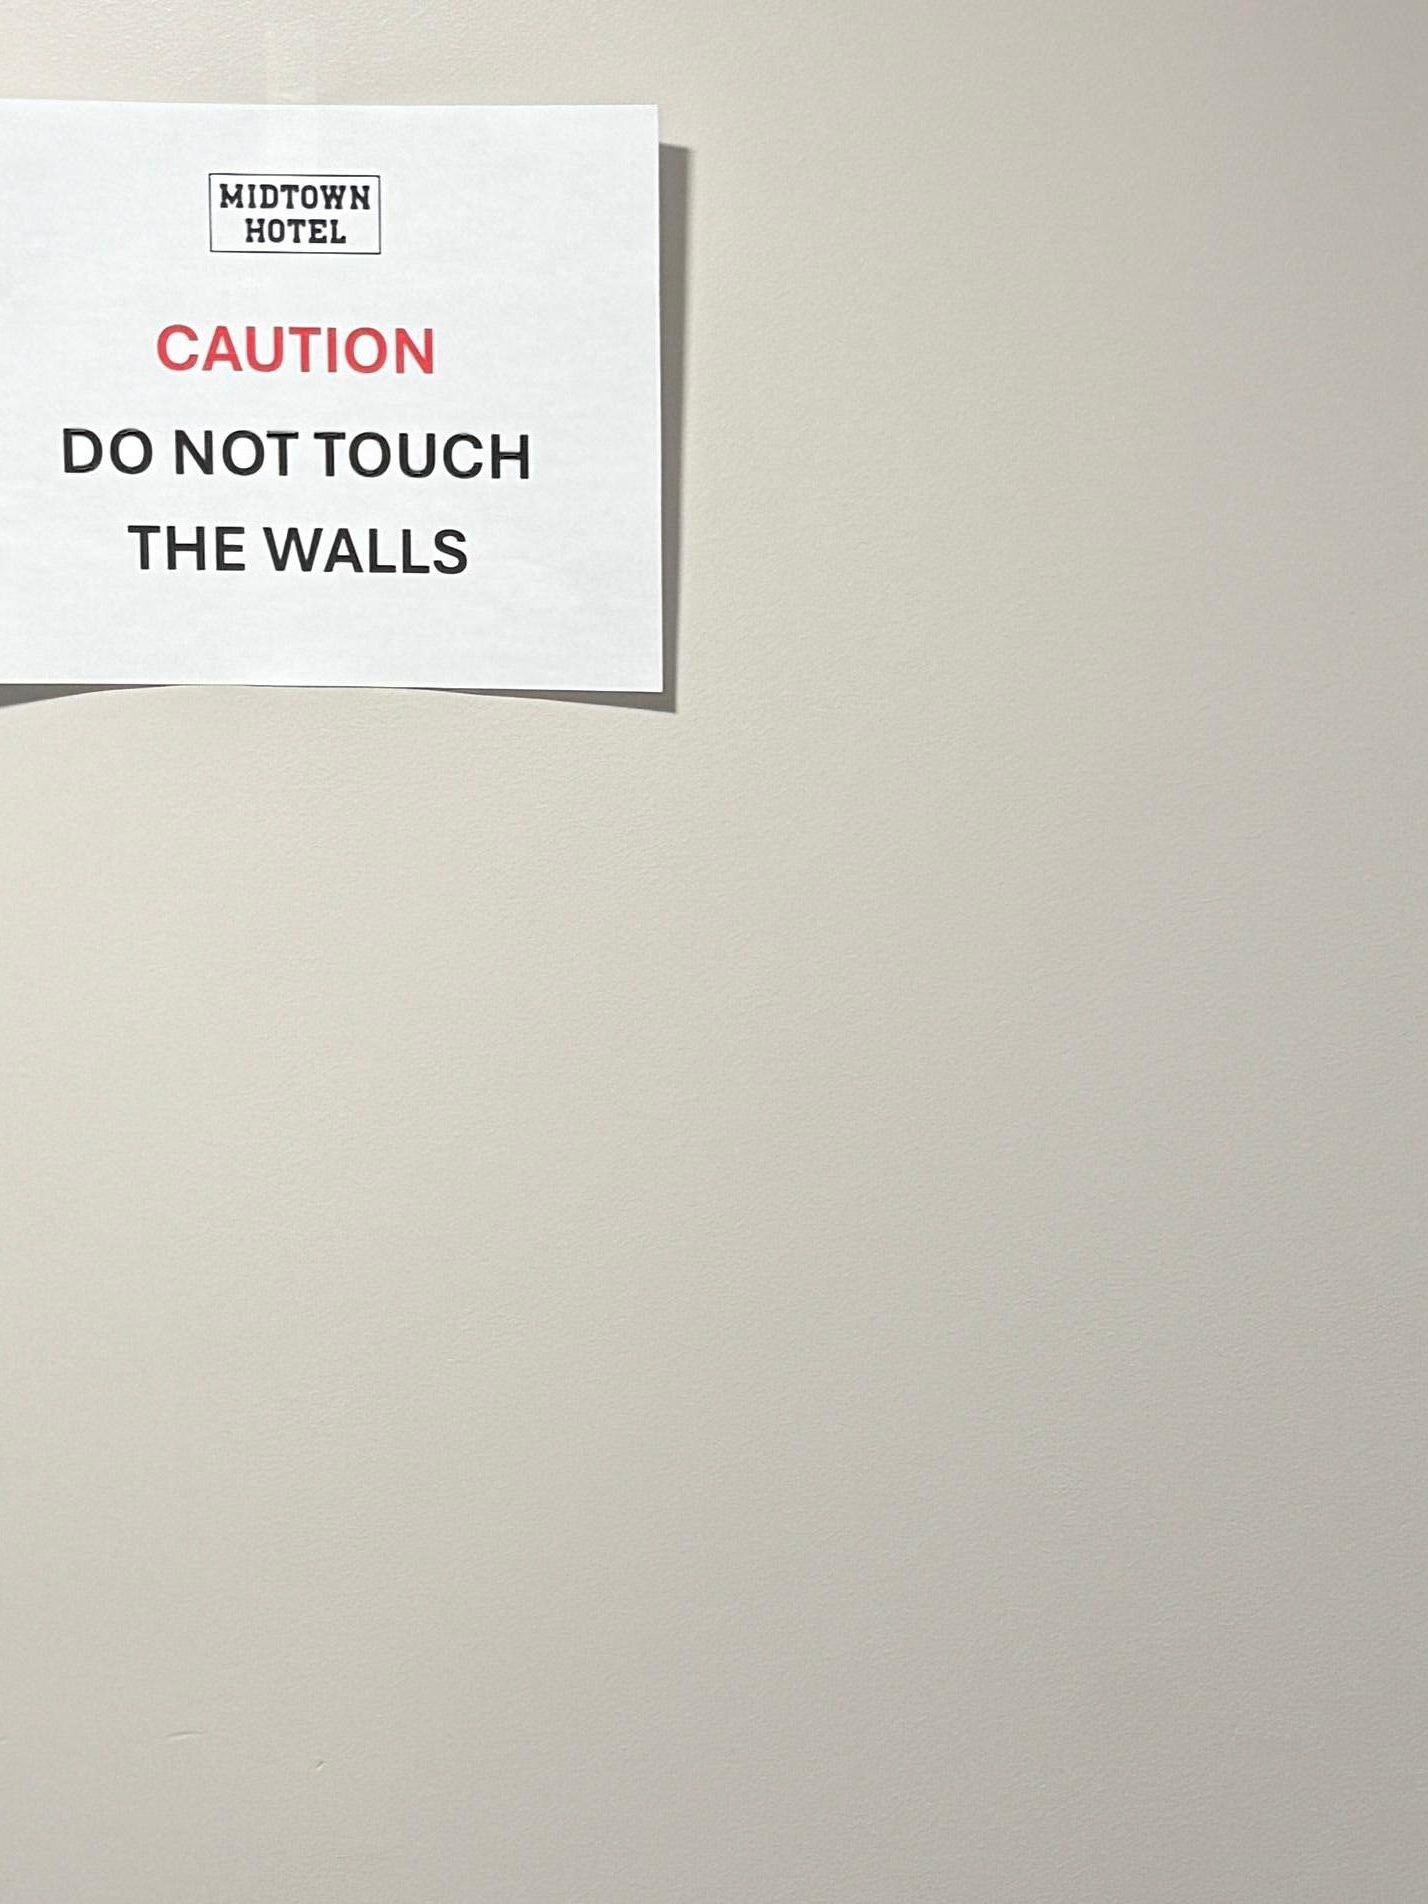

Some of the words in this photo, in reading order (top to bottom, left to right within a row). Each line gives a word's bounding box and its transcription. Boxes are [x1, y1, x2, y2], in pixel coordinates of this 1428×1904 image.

[220, 184, 370, 210] MIDTOWN
[246, 218, 346, 243] HOTEL
[157, 325, 432, 373] CAUTION
[63, 428, 152, 474] DO
[175, 430, 299, 476] NOT
[314, 432, 529, 479] TOUCH
[128, 525, 245, 571] THE
[263, 527, 467, 574] WALLS
